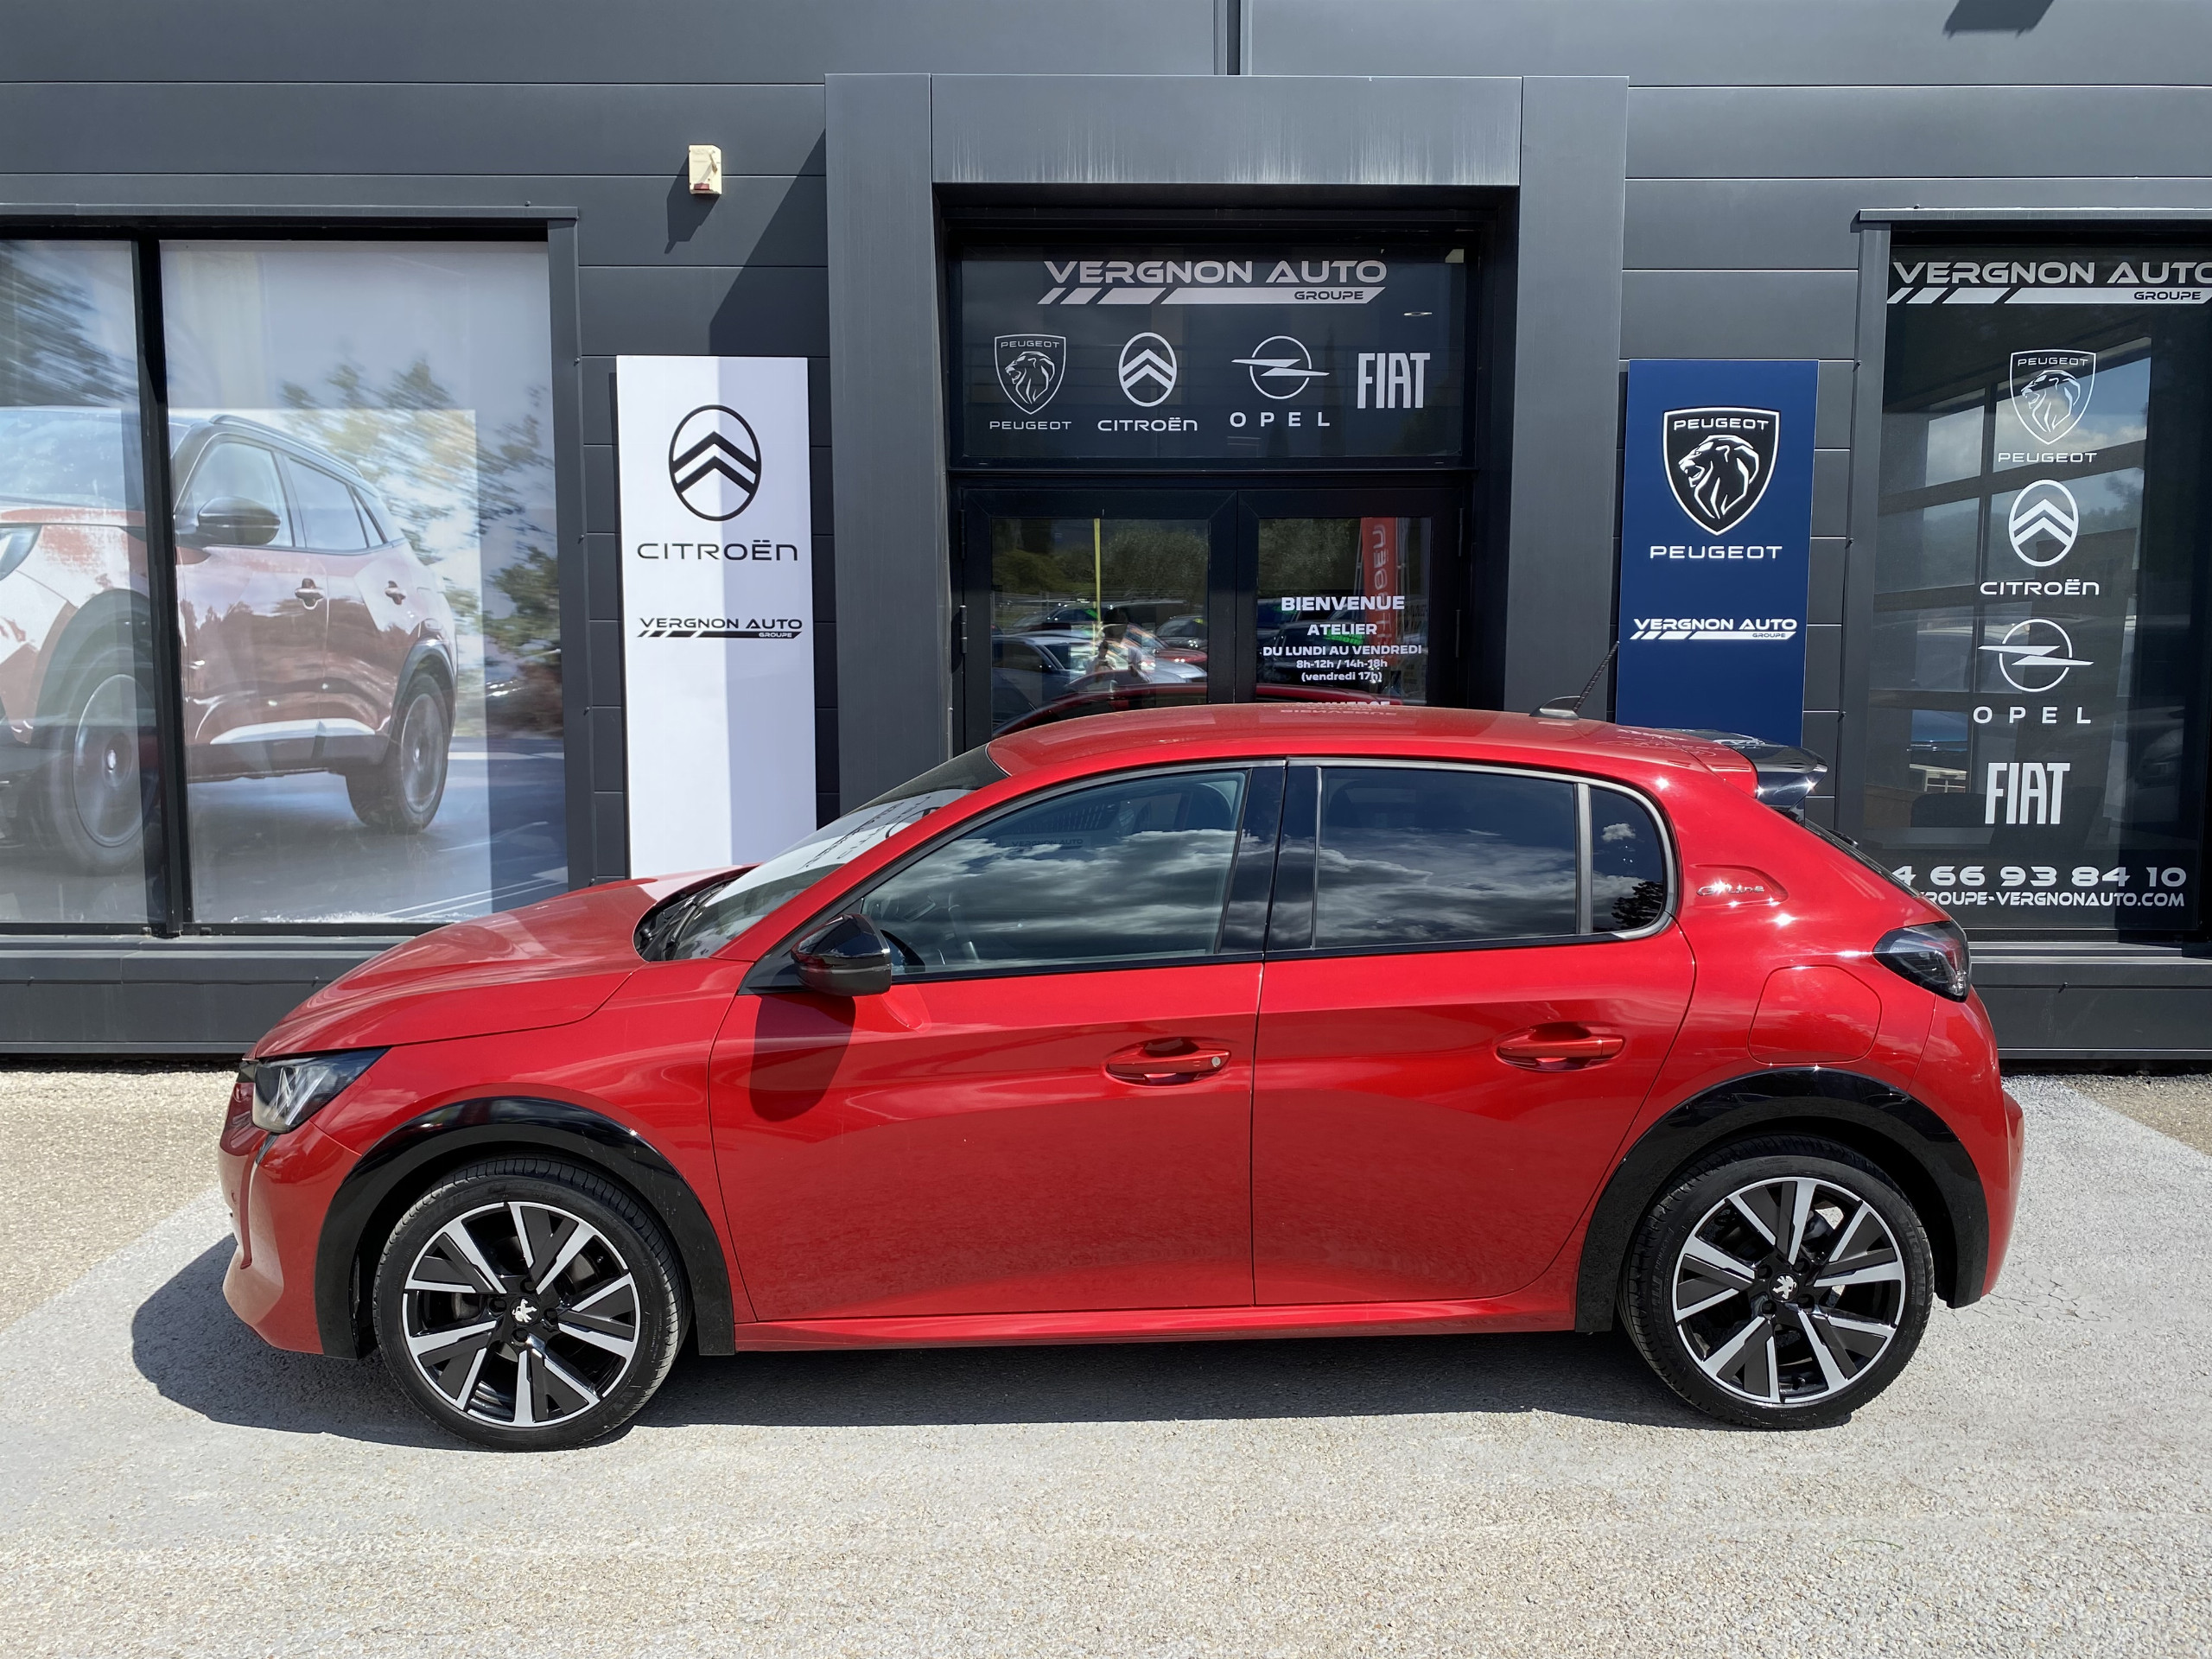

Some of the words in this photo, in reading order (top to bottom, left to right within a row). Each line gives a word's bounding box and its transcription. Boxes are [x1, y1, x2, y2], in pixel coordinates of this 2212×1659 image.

[1043, 260, 1253, 283] VERGNON
[1265, 260, 1387, 283] AUTO
[1892, 261, 2095, 284] VERGNON
[1294, 290, 1364, 301] GROUPE
[2133, 291, 2202, 301] GROUPE
[1000, 340, 1060, 349] PEUGEOT
[2017, 357, 2089, 367] PEUGEOT
[1357, 353, 1431, 410] FIAT
[989, 421, 1072, 430] PEUGEOT
[1097, 416, 1198, 432] CITROËN
[1230, 411, 1331, 428] OPEL
[1673, 417, 1770, 431] PEUGEOT
[1997, 452, 2098, 463] PEUGEOT
[637, 539, 798, 562] CITROËN
[1649, 545, 1783, 559] PEUGEOT
[1980, 578, 2101, 596] CITROËN
[1281, 595, 1406, 612] BIENVENUE
[639, 618, 740, 629] VERGNON
[745, 619, 803, 630] AUTO
[1306, 623, 1378, 636] ATELIER
[1633, 618, 1733, 631] VERGNON
[1738, 618, 1797, 631] AUTO
[1262, 646, 1282, 657] DU
[1285, 646, 1326, 656] LUNDI
[1329, 645, 1349, 656] AU
[1352, 645, 1422, 655] VENDREDI
[1295, 659, 1334, 669] 8h-12h
[1344, 658, 1388, 669] 14h-18h
[1300, 671, 1356, 682] (vendredi
[1973, 706, 2092, 724] OPEL
[1985, 762, 2071, 825] FIAT
[1929, 866, 1986, 887] 66
[1999, 866, 2057, 887] 93
[2071, 866, 2131, 887] 84
[2145, 867, 2187, 887] 10
[1920, 891, 2185, 907] ROUPE-VERGNONAUTO.COM
